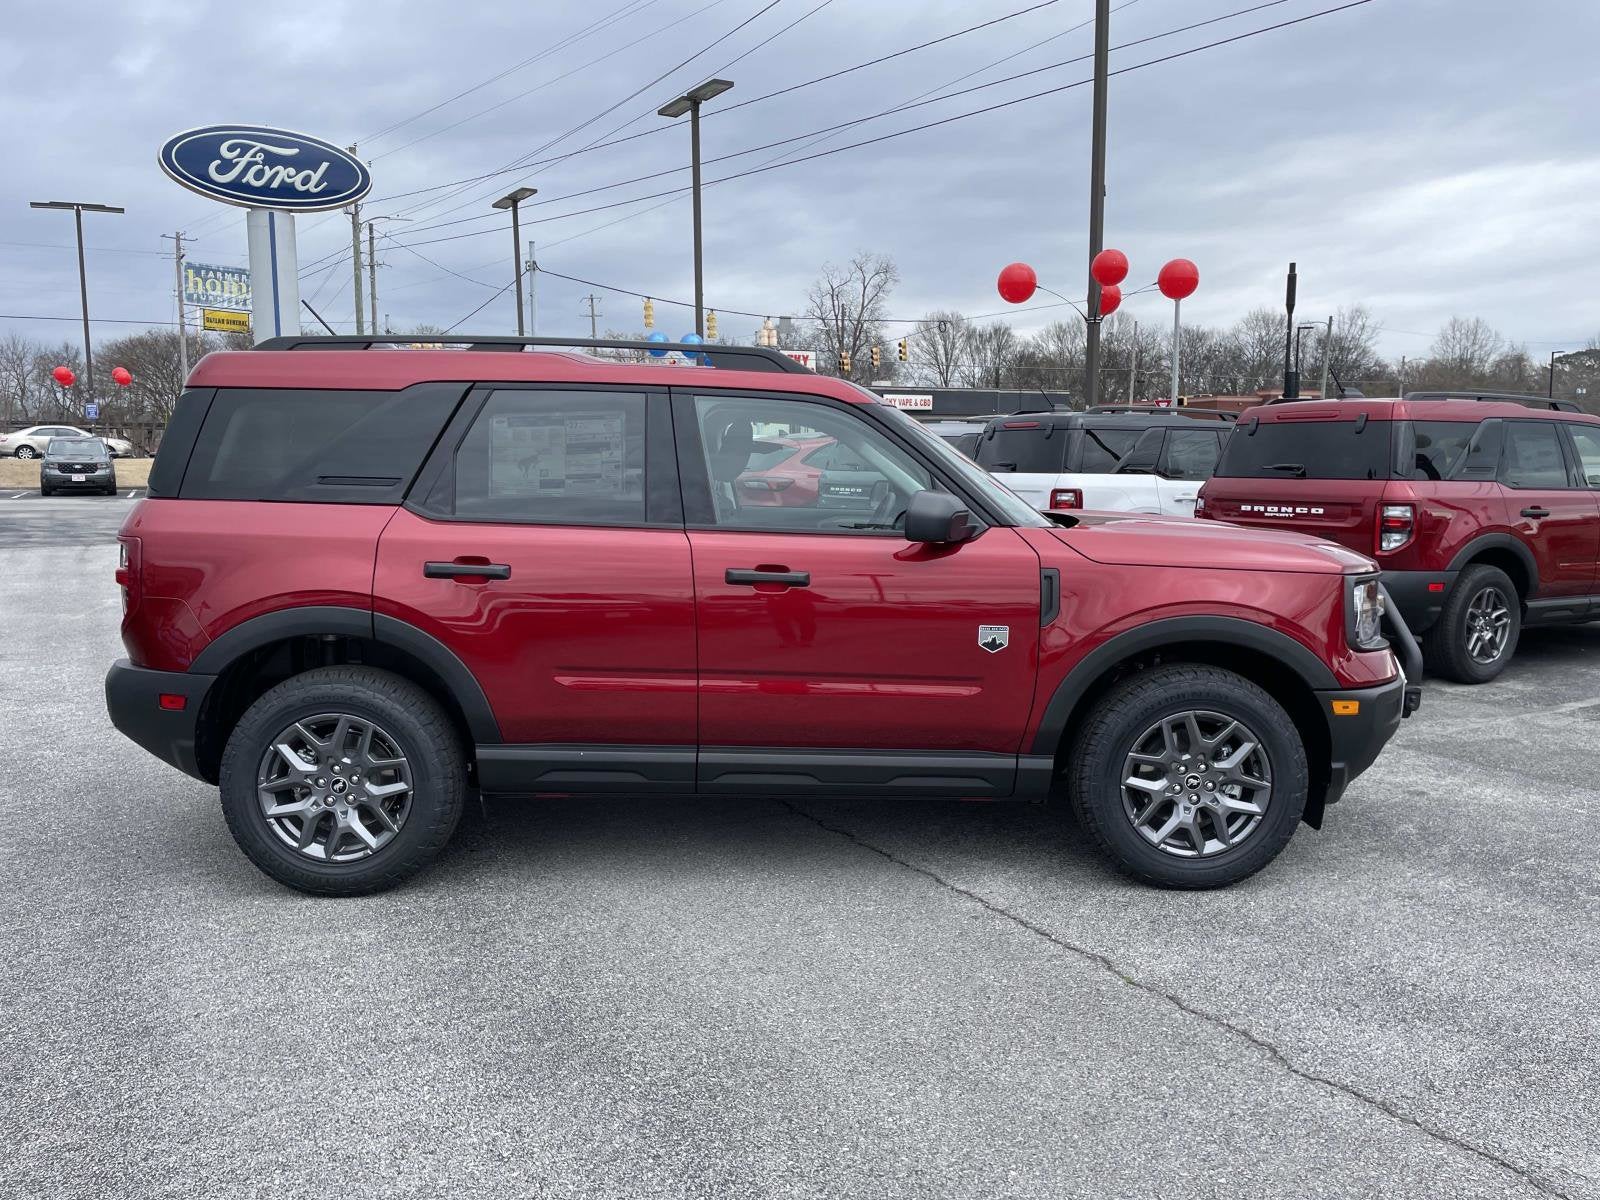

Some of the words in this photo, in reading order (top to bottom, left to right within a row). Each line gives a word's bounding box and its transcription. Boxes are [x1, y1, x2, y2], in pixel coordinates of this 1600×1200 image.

[208, 139, 330, 193] Ford
[187, 269, 251, 297] hom
[898, 398, 912, 406] VAPE
[920, 398, 931, 407] CBD
[1240, 505, 1324, 514] BRONCO
